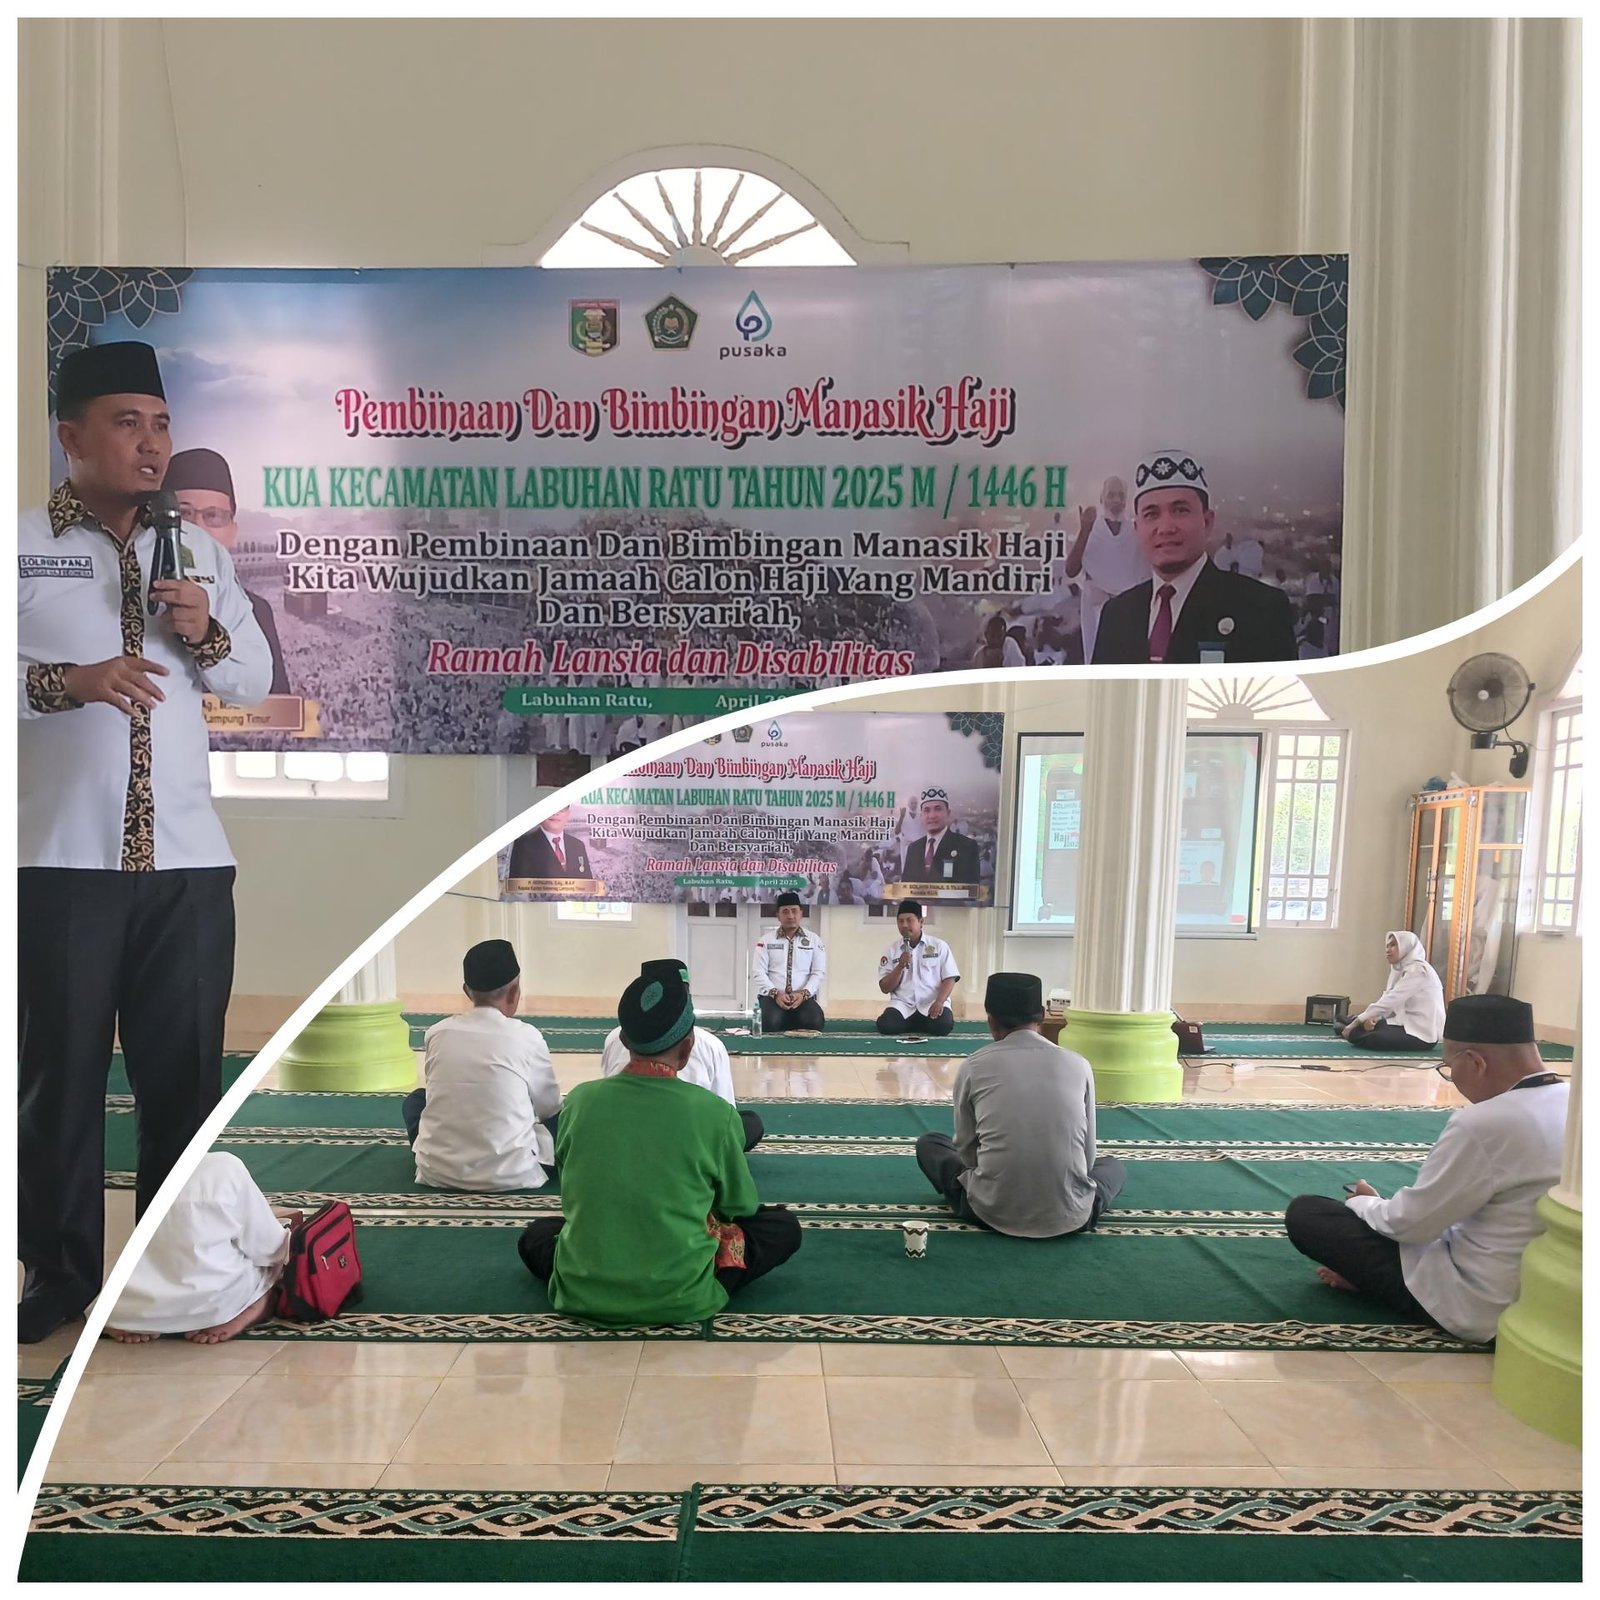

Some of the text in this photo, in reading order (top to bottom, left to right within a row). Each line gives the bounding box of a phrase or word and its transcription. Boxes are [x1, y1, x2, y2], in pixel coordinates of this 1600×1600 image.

[719, 343, 787, 360] pusaka
[335, 375, 1016, 449] Pembinaan Dan Bimbingan Manasik Haji
[263, 463, 1068, 520] KUA KECAMATAN LABUHAN RATU TAHUN 2025 M / 1446 H
[279, 531, 1065, 562] Dengan Pembinaan Dan Bimbingan Manasik Haji
[60, 559, 90, 568] PANJI
[290, 565, 1053, 597] Kita Wujudkan Jamaah Calon Haji Yang Mandiri
[538, 600, 602, 625] Dan
[428, 640, 914, 676] Ramah Lansia dan Disabilitas
[521, 692, 599, 707] Labuhan
[605, 693, 653, 709] Ratu,
[715, 694, 759, 711] April
[684, 758, 714, 779] Dan
[715, 757, 787, 783] Bimbingan
[788, 755, 844, 781] Manasik
[842, 756, 876, 784] Haji
[606, 788, 674, 805] KECAMATAN
[676, 788, 730, 806] LABUHAN
[733, 789, 763, 806] RATU
[765, 789, 803, 807] TAHUN
[806, 790, 833, 808] 2025
[836, 790, 846, 808] M
[848, 790, 854, 812] /
[858, 791, 884, 809] 1446
[887, 791, 895, 808] H
[587, 813, 895, 829] Dengan Pembinaan Dan Bimbingan Manasik Haji
[592, 828, 889, 843] Kita Wujudkan Jamaah Calon Haji Yang Mandiri
[690, 841, 714, 852] Dan
[646, 858, 836, 873] Ramah Lansia dan Disabilitas
[759, 879, 778, 887] April
